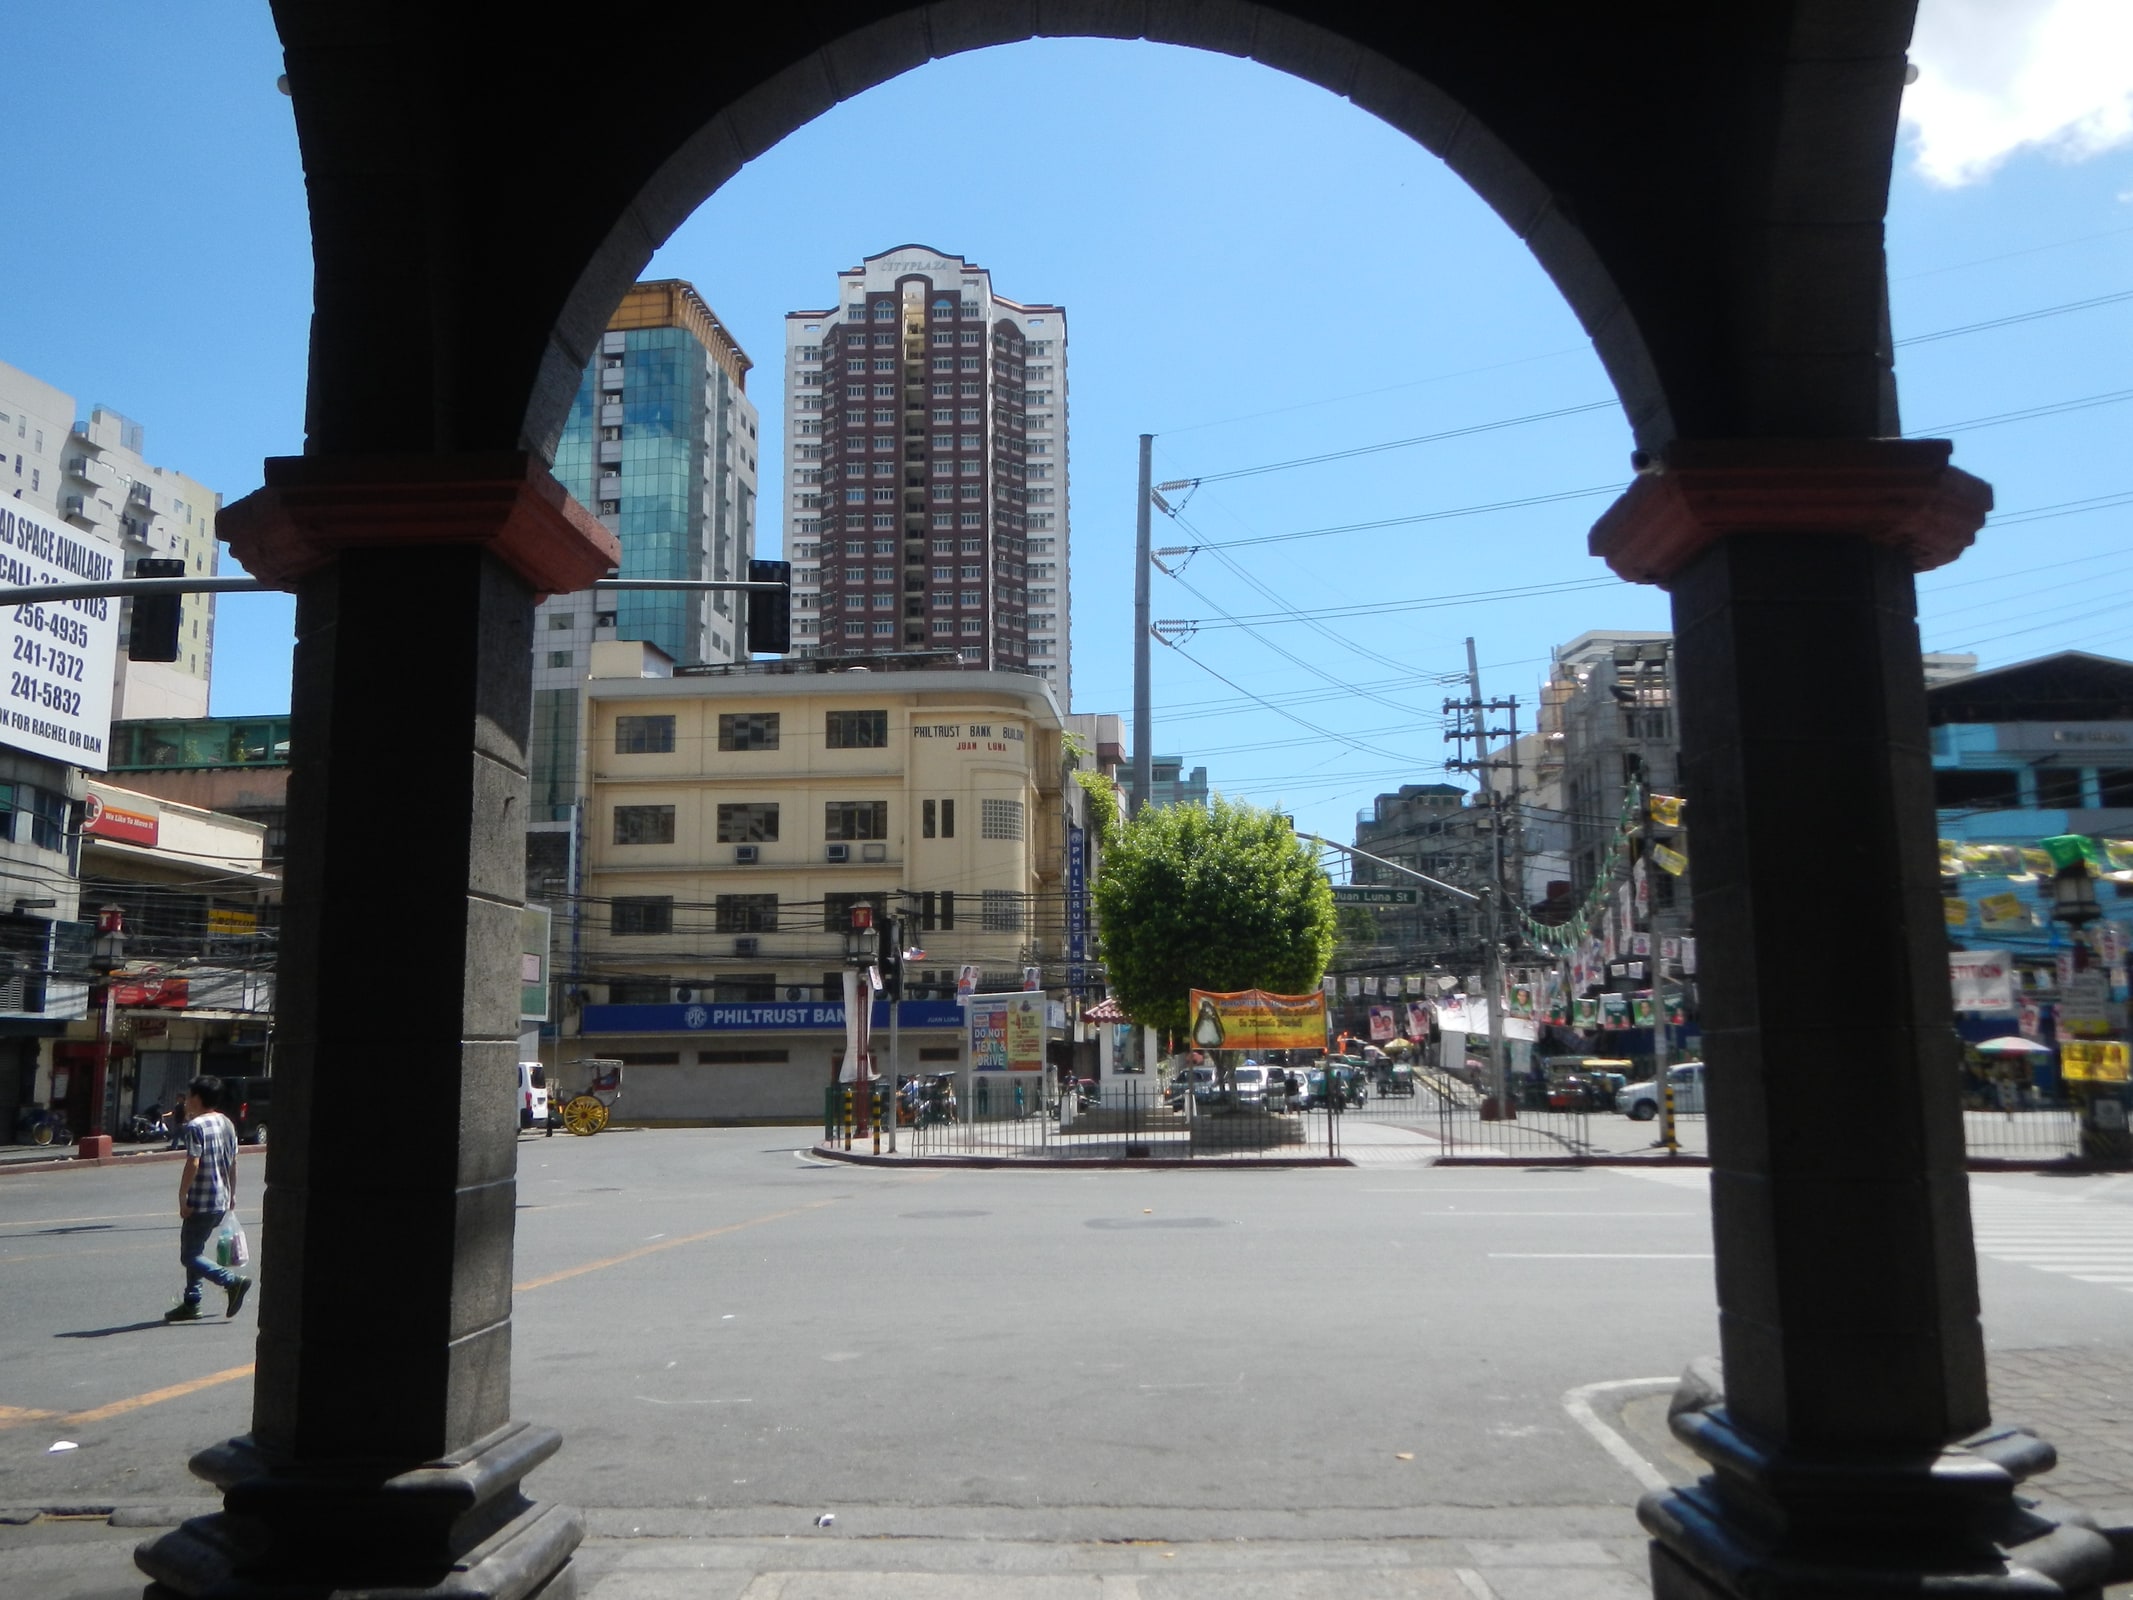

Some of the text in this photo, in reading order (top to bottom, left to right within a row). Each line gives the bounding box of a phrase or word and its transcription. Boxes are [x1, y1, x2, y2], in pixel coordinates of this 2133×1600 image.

[0, 508, 113, 581] AD SPACE AVAILABLE
[13, 601, 88, 648] 256-4935
[13, 635, 84, 682] 241-7372
[11, 671, 81, 717] 241-5832
[12, 712, 30, 733] FOR
[32, 718, 67, 744] RACHEL
[69, 730, 82, 748] OR
[83, 734, 101, 753] DAN
[914, 725, 960, 738] PHILTRUST
[969, 725, 991, 737] BANK
[956, 742, 1006, 751] JUAN LUNA
[1334, 892, 1408, 902] Juan Luna St
[713, 1009, 808, 1024] PHILTRUST
[813, 1008, 847, 1023] BAN
[974, 1028, 1006, 1038] DO NOT
[975, 1041, 1007, 1053] TEXT &
[978, 1054, 1004, 1066] DRIVE
